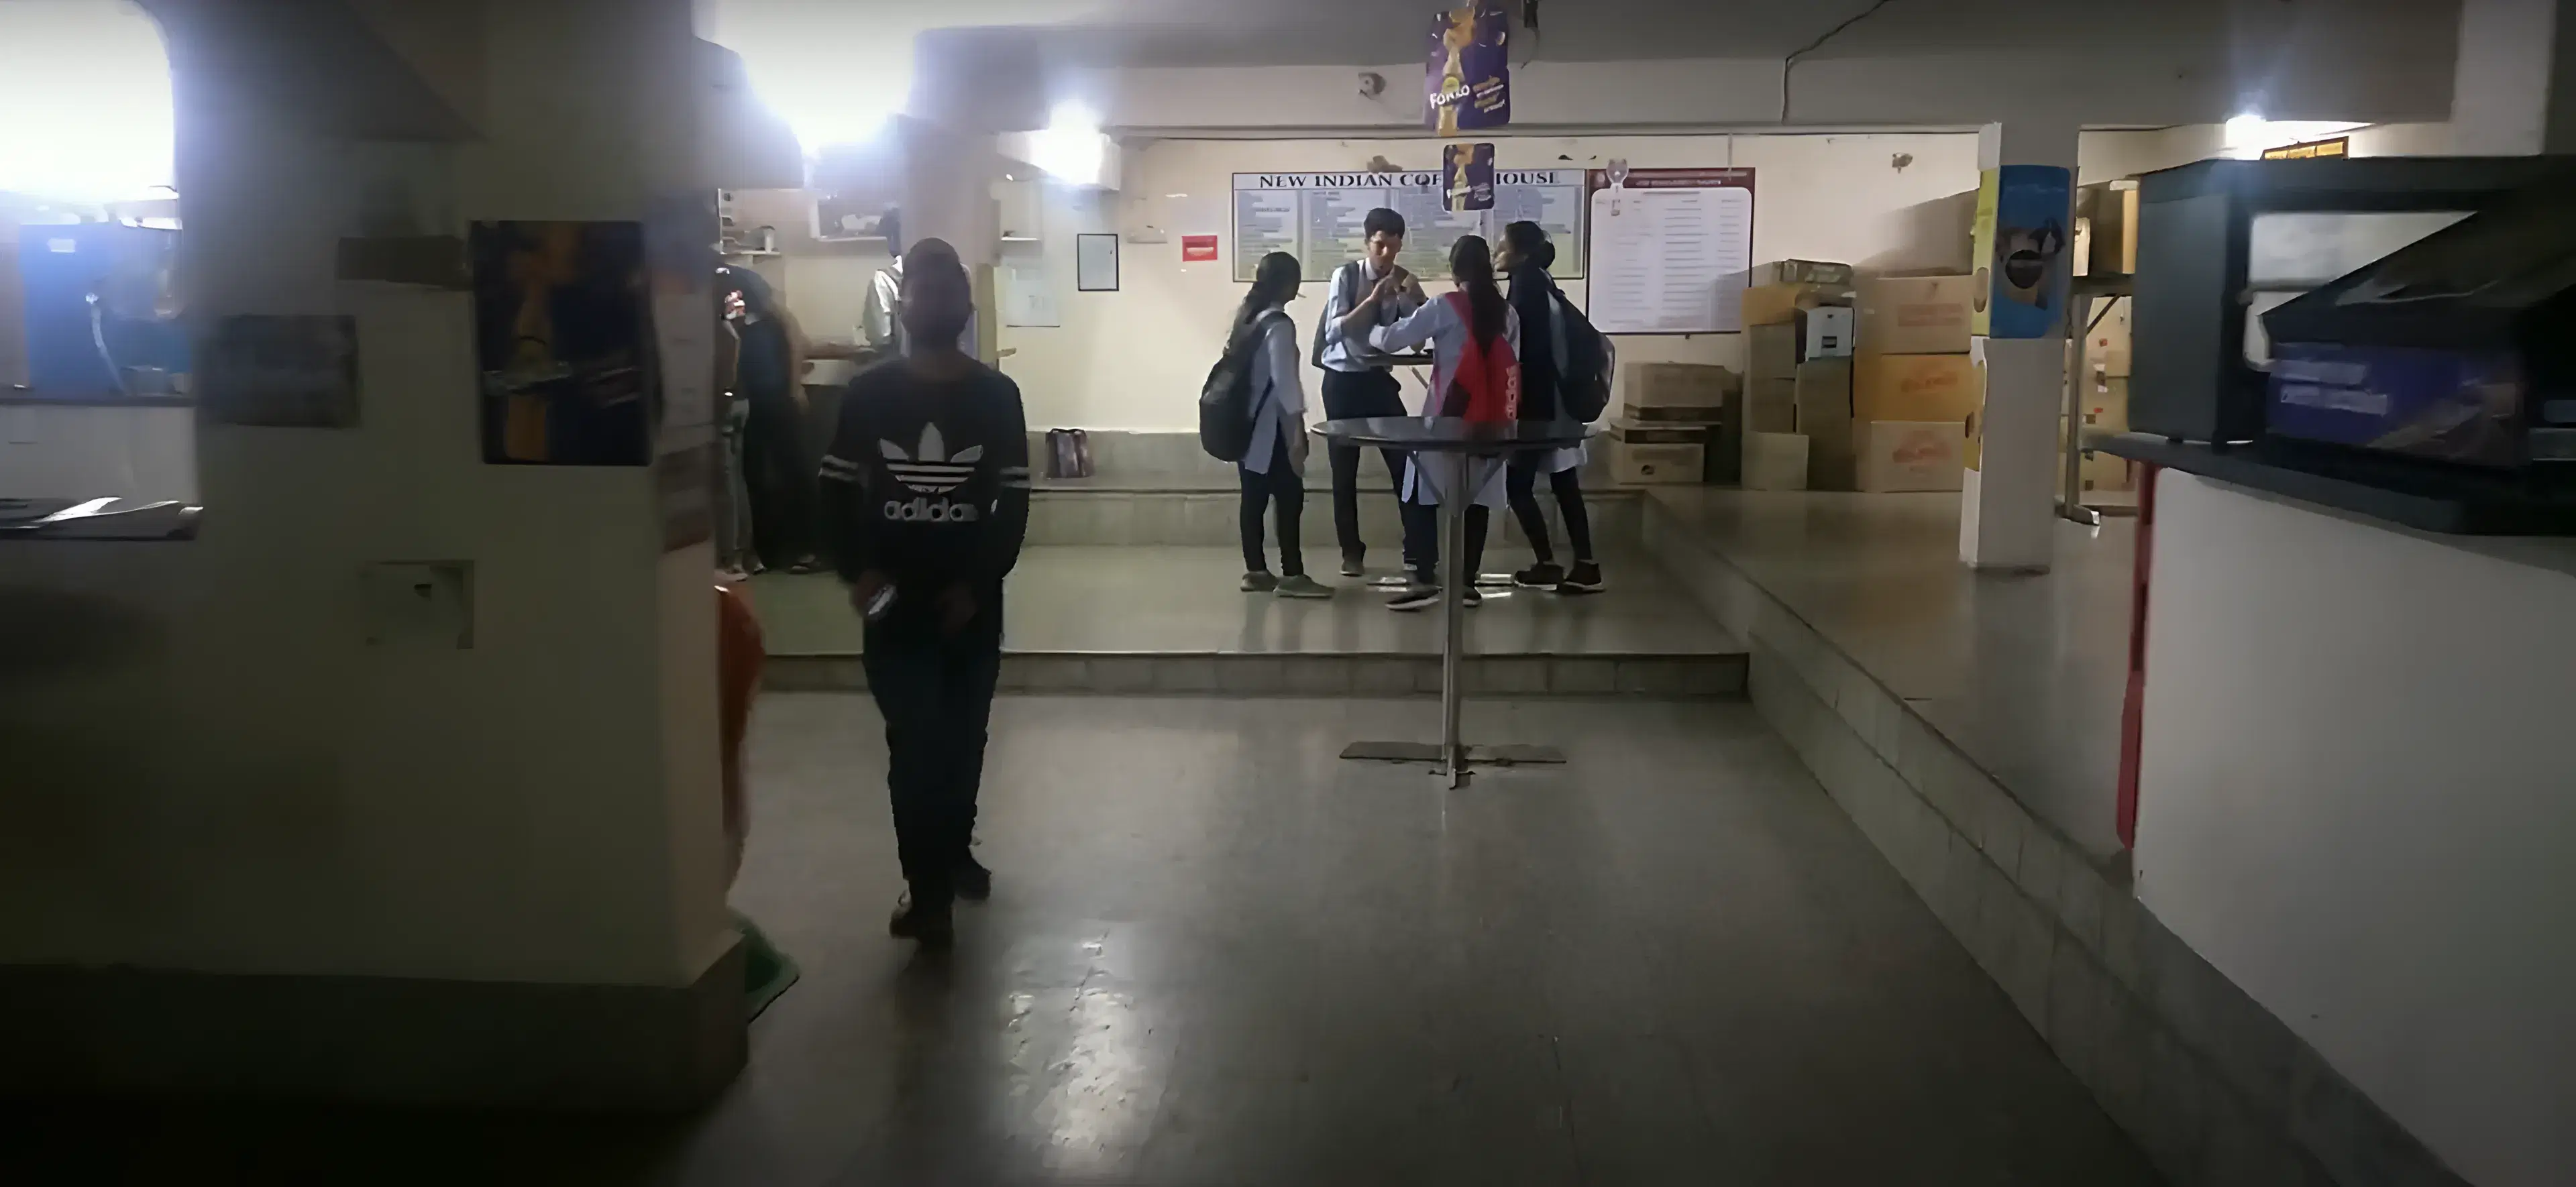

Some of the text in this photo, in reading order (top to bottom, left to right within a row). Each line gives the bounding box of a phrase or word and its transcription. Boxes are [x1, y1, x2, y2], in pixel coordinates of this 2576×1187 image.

[1260, 175, 1307, 188] NEW
[1315, 174, 1392, 187] INDIAN
[1399, 173, 1442, 186] COF
